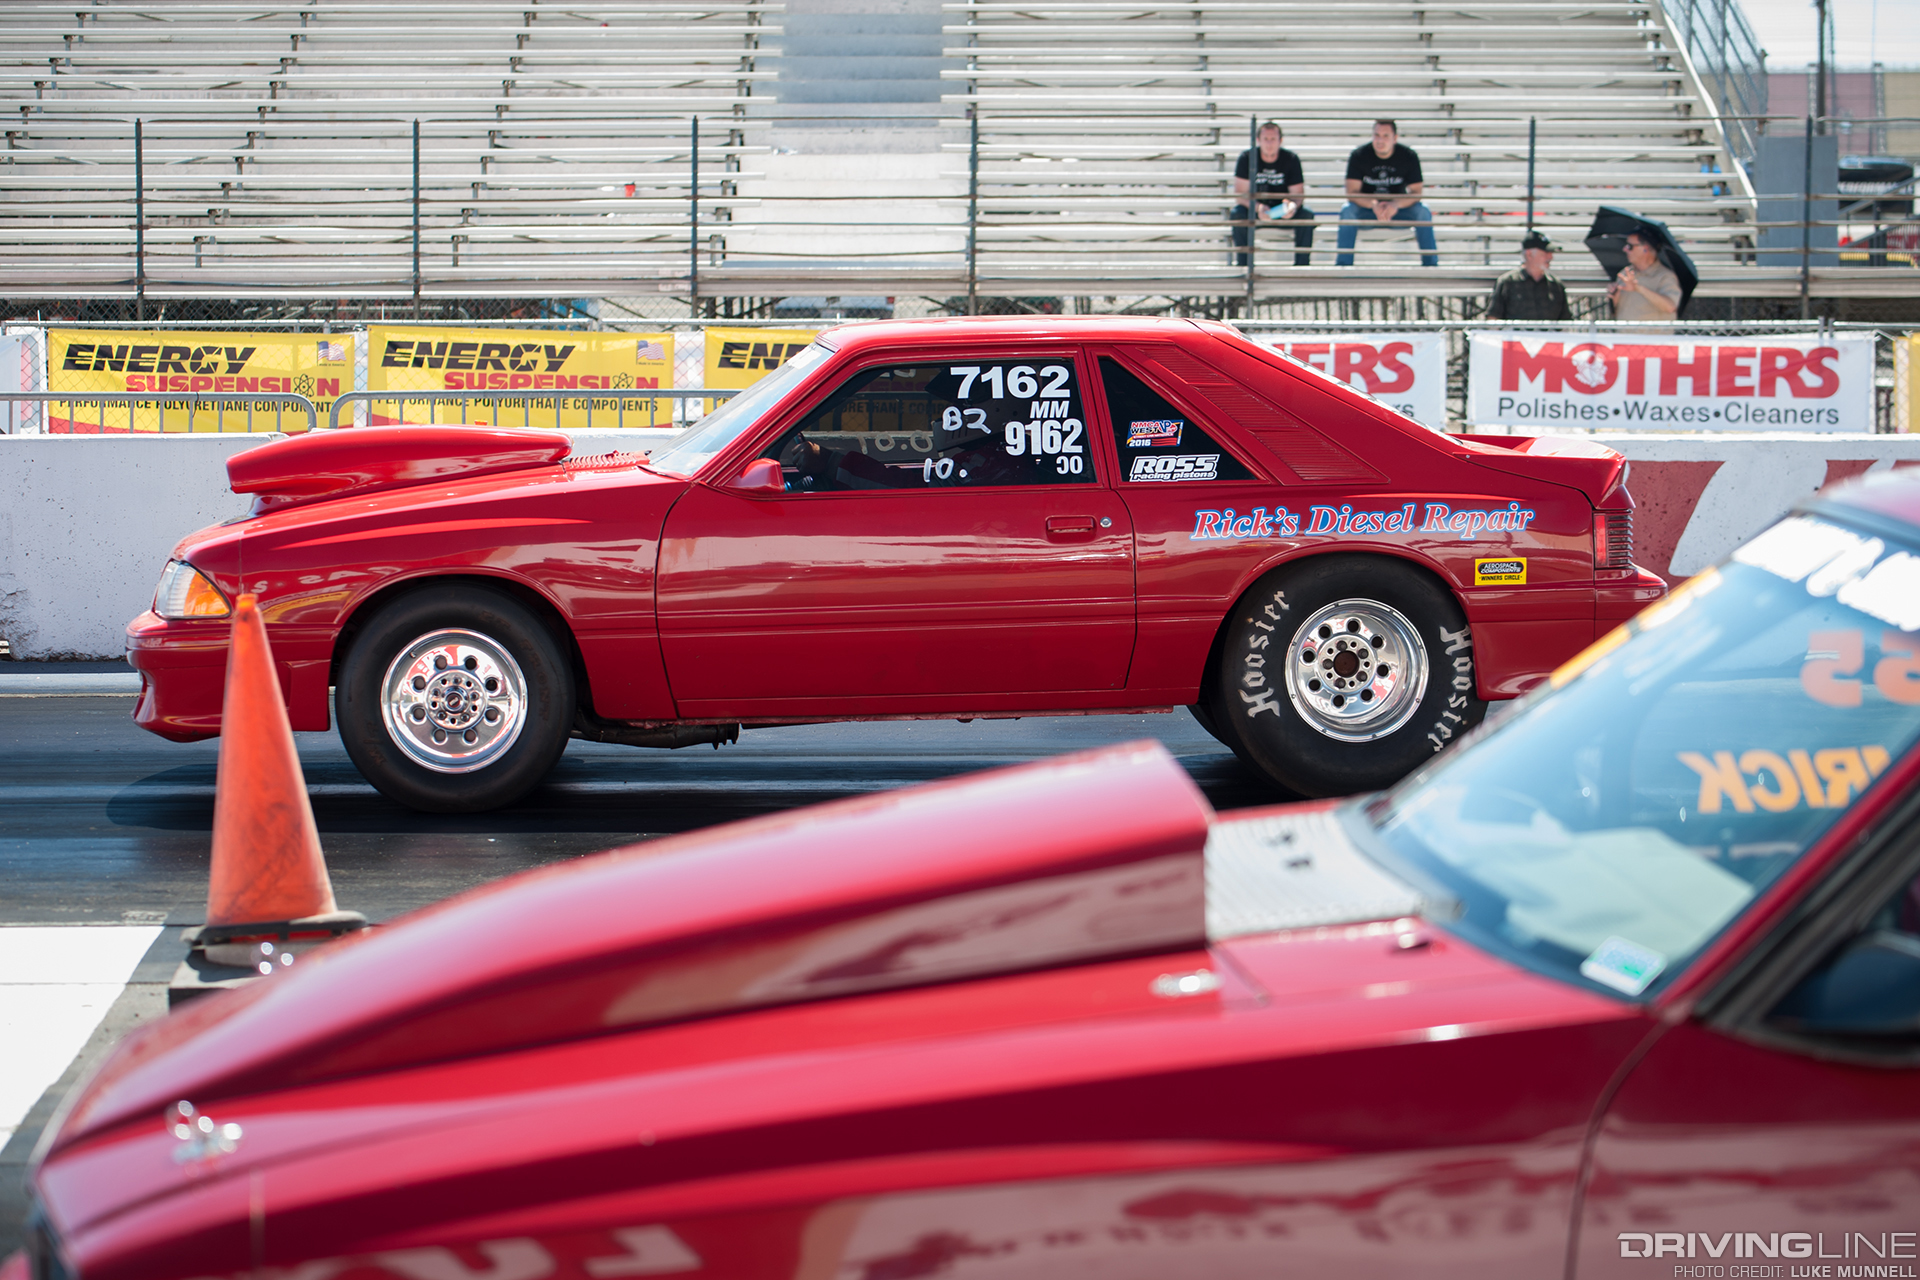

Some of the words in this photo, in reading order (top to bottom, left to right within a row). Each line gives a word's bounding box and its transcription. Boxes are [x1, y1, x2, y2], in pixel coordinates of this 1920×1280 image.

[62, 343, 257, 375] ENERGY
[381, 340, 577, 372] ENERGY
[1272, 342, 1415, 394] ERS
[1500, 341, 1841, 398] MOTHERS
[950, 365, 1071, 399] 7162
[1029, 400, 1069, 418] MM
[1005, 418, 1083, 456] 9162
[1133, 457, 1216, 474] ROSS
[1133, 472, 1171, 480] racing
[1172, 472, 1214, 480] pistons
[1190, 507, 1299, 540] Rick's
[1305, 503, 1413, 535] Diesel
[1421, 502, 1536, 541] Repair
[1238, 590, 1290, 718] Hoosier
[1427, 624, 1475, 752] Hoosier
